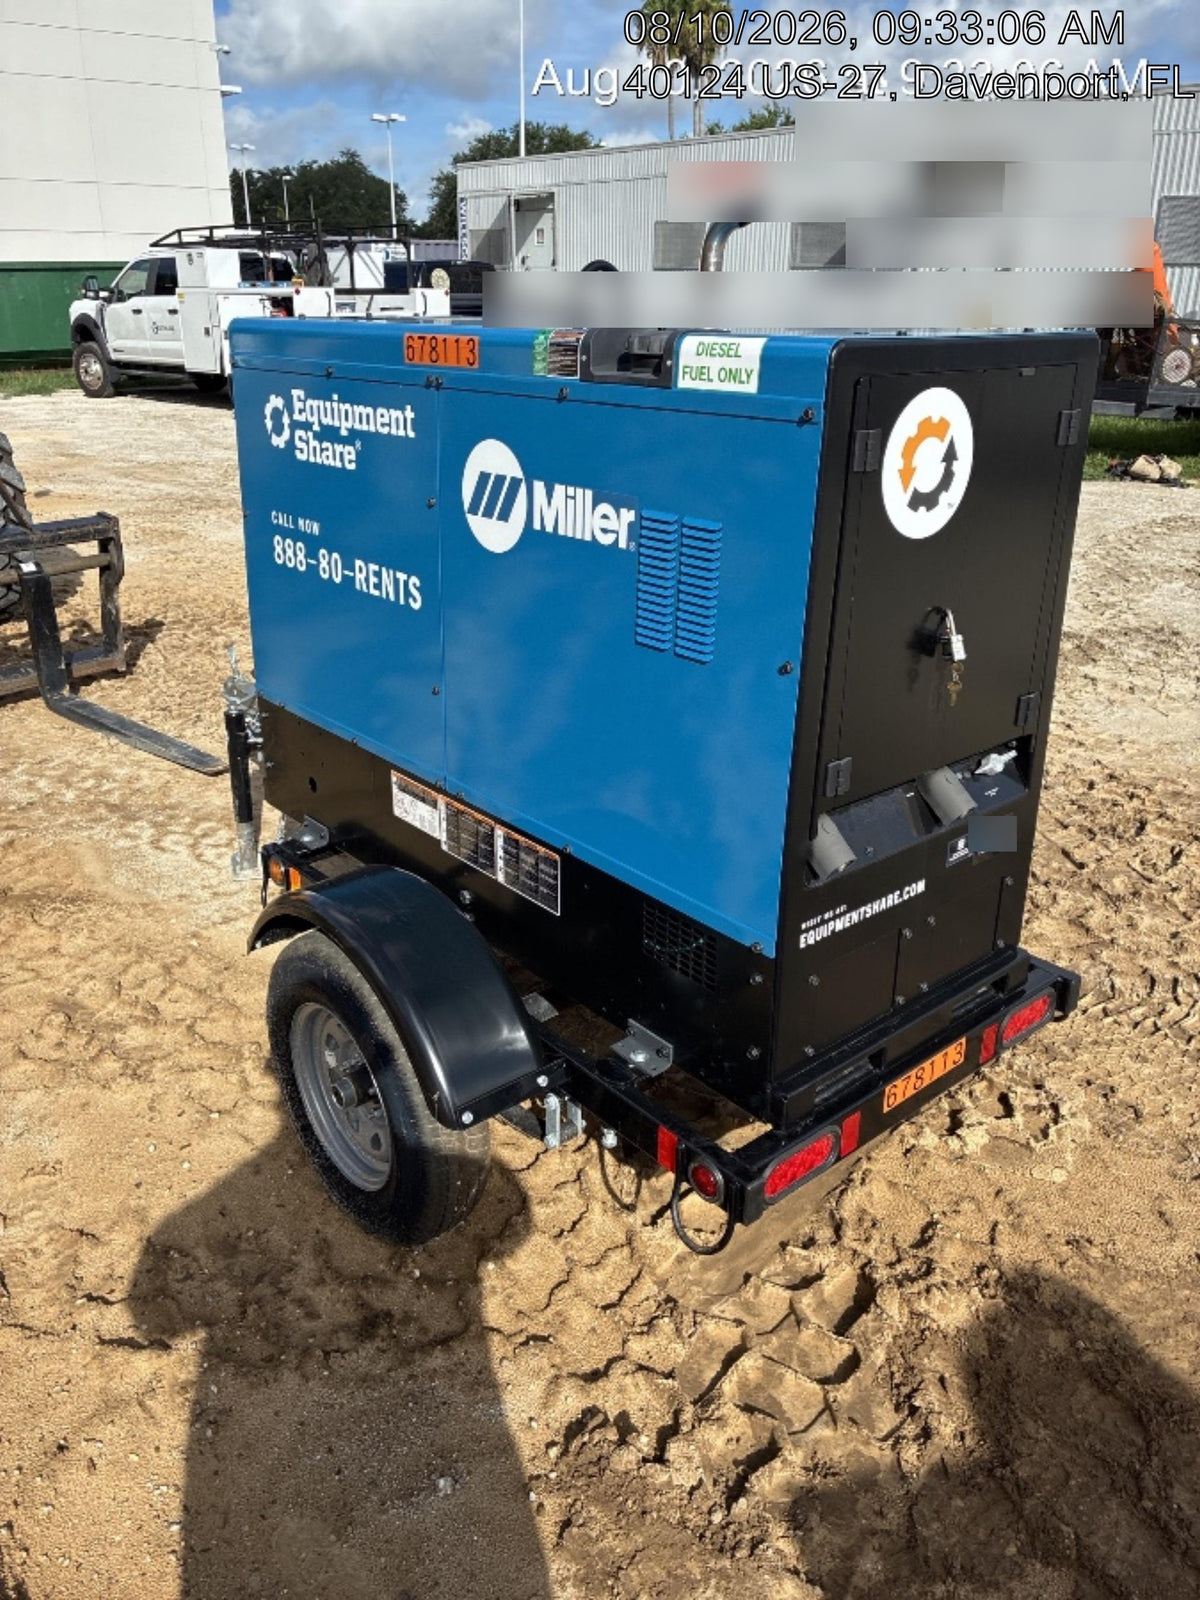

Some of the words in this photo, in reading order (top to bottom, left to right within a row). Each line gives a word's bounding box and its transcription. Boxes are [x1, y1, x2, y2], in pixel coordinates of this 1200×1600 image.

[405, 335, 477, 367] 678113
[696, 341, 742, 358] DIESEL
[682, 365, 714, 383] FUEL
[717, 366, 754, 385] ONLY
[291, 389, 415, 438] Equipment
[271, 510, 295, 530] CALL
[298, 517, 321, 536] NOW
[273, 534, 423, 610] 888-80-RENTS
[799, 878, 926, 949] EQUIPMENTSHARE.COM
[886, 1041, 964, 1108] 678113
